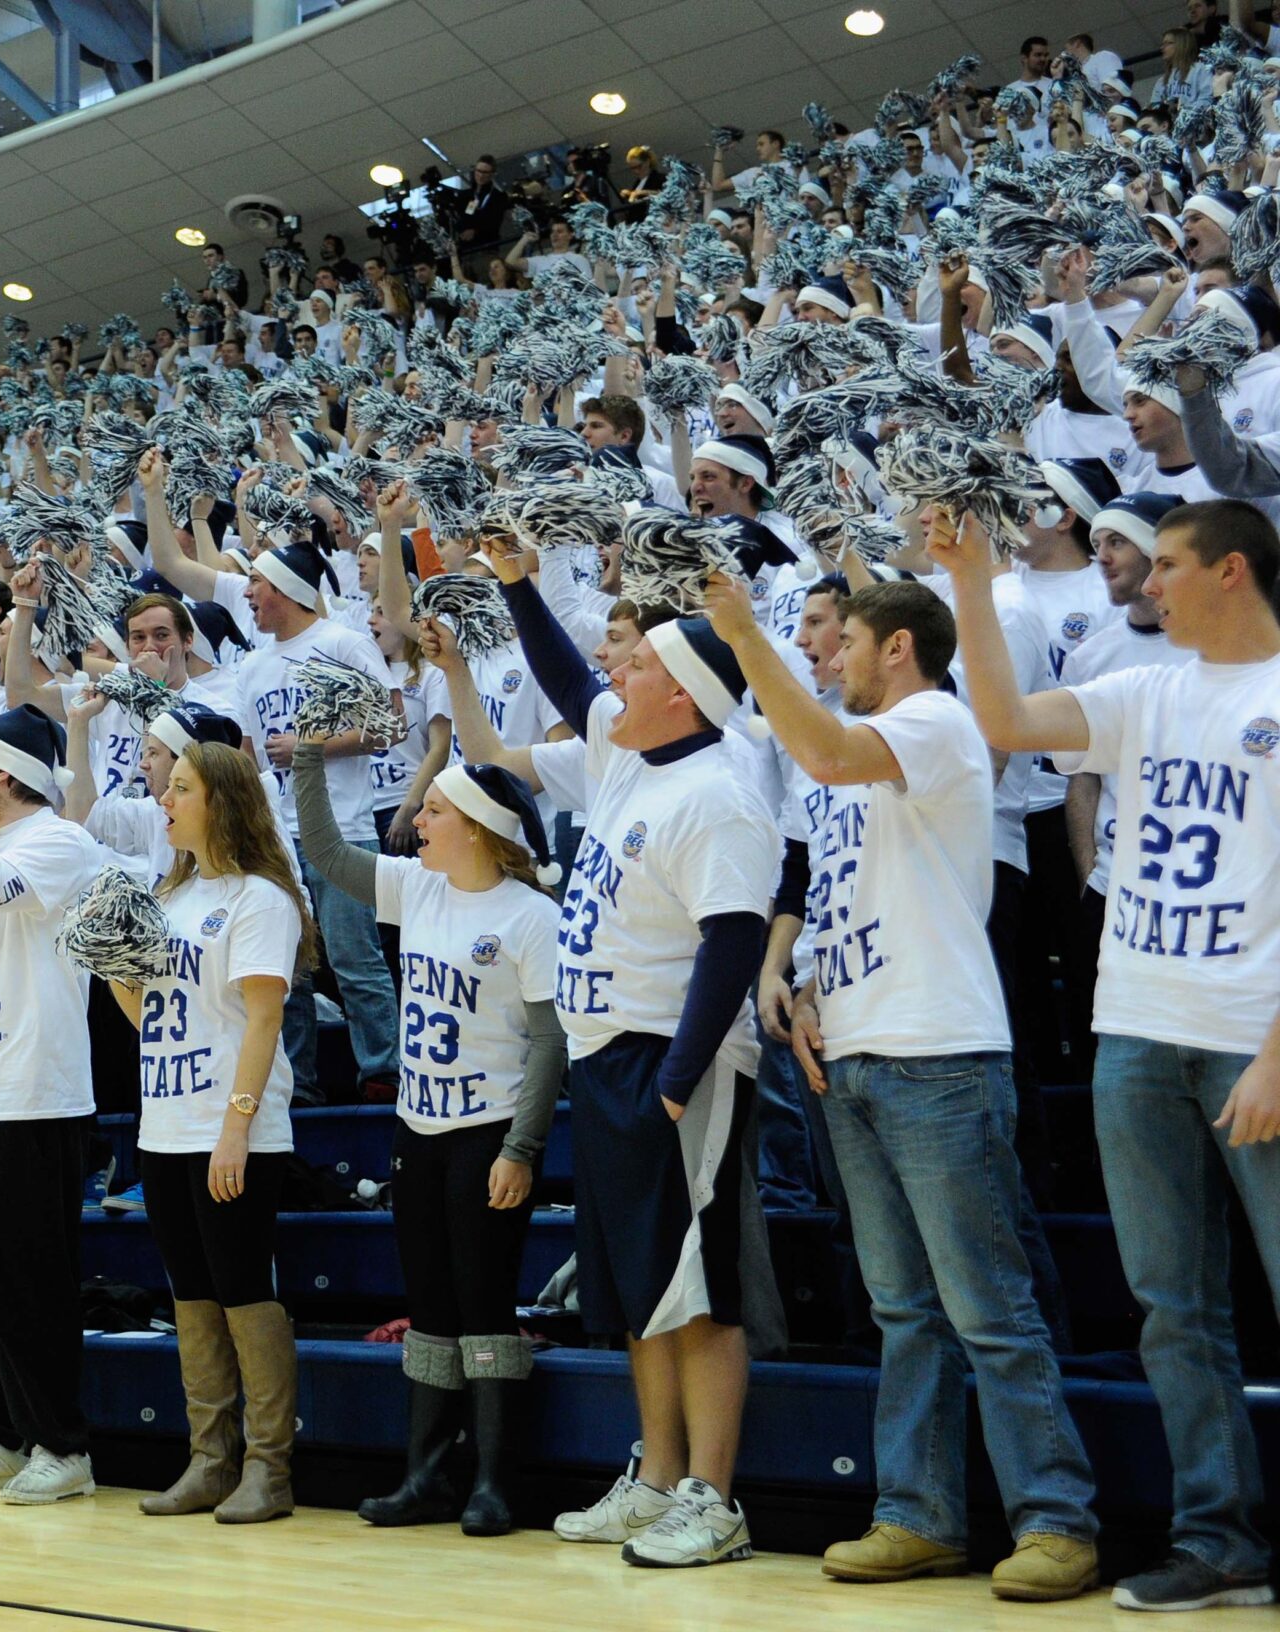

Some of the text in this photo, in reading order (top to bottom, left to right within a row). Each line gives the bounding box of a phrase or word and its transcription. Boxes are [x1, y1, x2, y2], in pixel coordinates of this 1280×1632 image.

[774, 586, 807, 627] PE
[624, 834, 646, 849] REC
[820, 802, 868, 860] ENN
[1139, 813, 1220, 890] 23
[573, 834, 624, 910] ENN
[558, 888, 599, 957] 23
[1112, 884, 1246, 958] STATE
[813, 917, 884, 997] TATE
[142, 988, 187, 1043] 23
[556, 962, 614, 1014] ATE
[405, 1001, 460, 1066] 23
[141, 1047, 212, 1098] TATE
